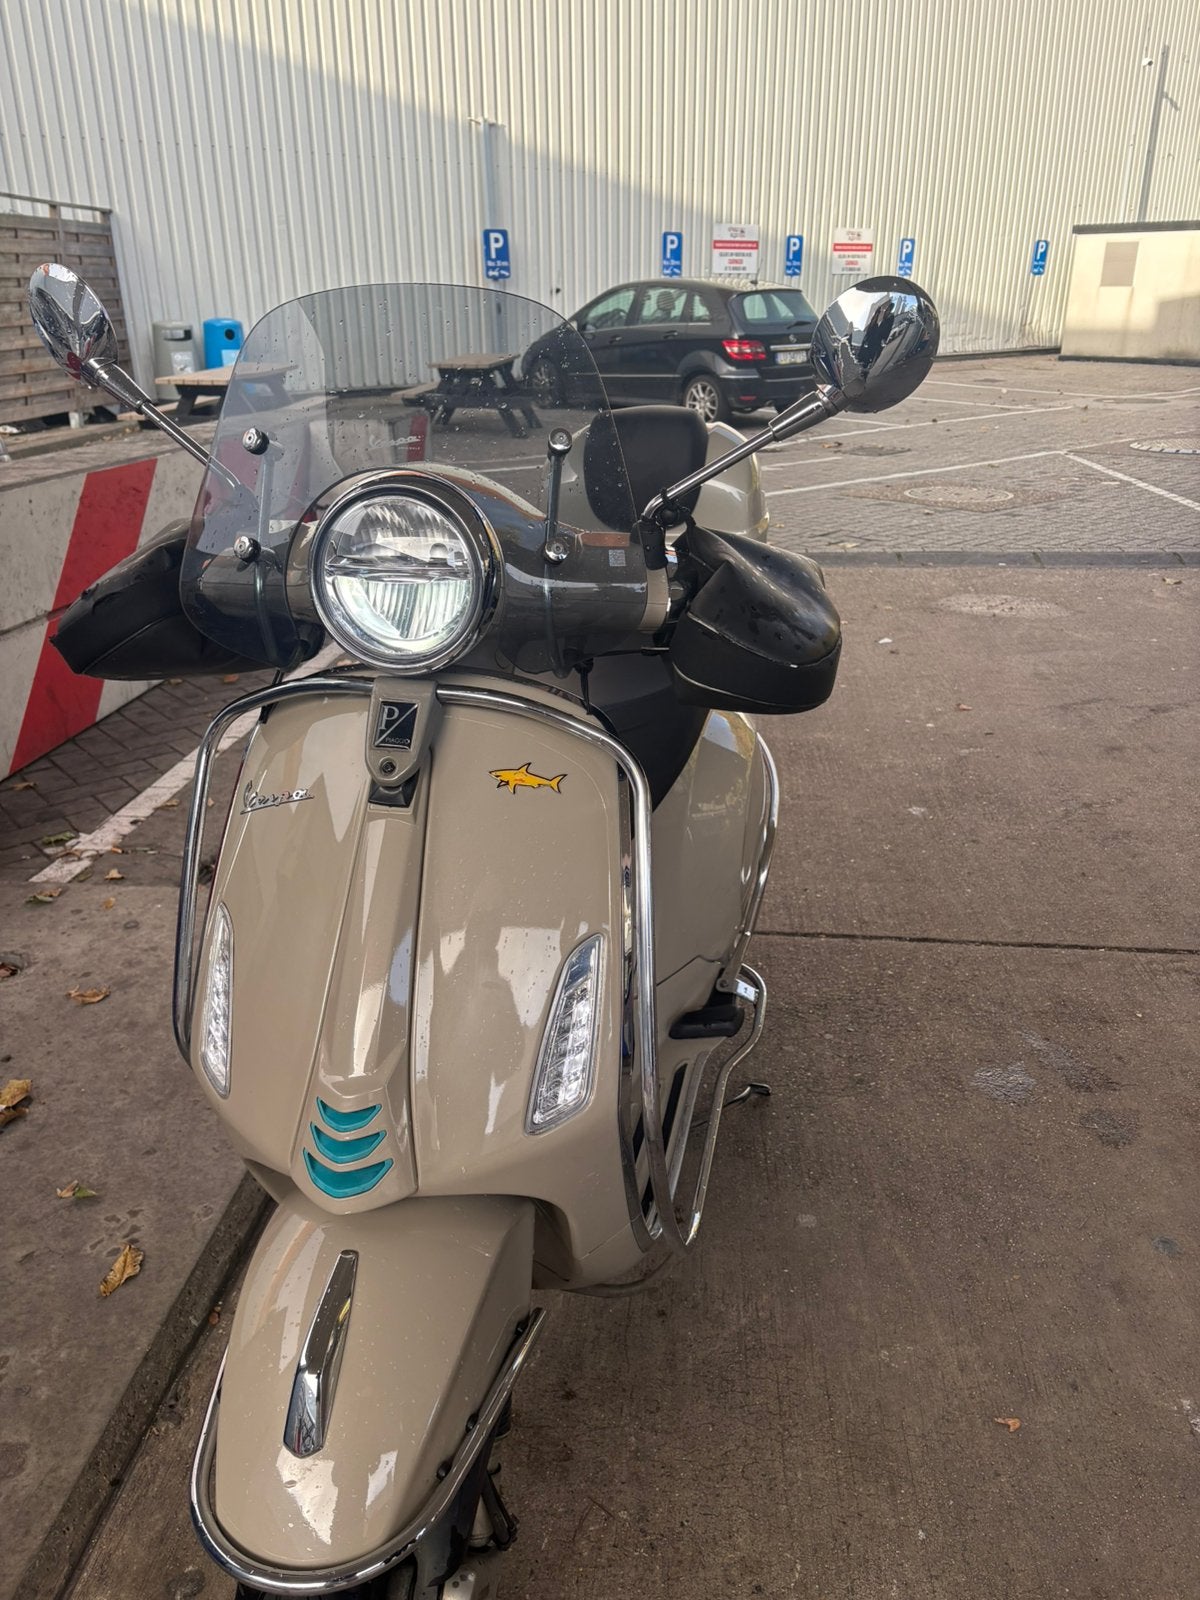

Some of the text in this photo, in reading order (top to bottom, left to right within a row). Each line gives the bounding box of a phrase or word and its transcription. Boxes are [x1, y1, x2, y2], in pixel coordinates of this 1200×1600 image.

[489, 232, 504, 259] P
[666, 235, 678, 259] P
[789, 237, 800, 260] P
[901, 240, 912, 261] P
[1037, 241, 1046, 260] P
[379, 705, 400, 730] P
[240, 780, 315, 815] Vespa
